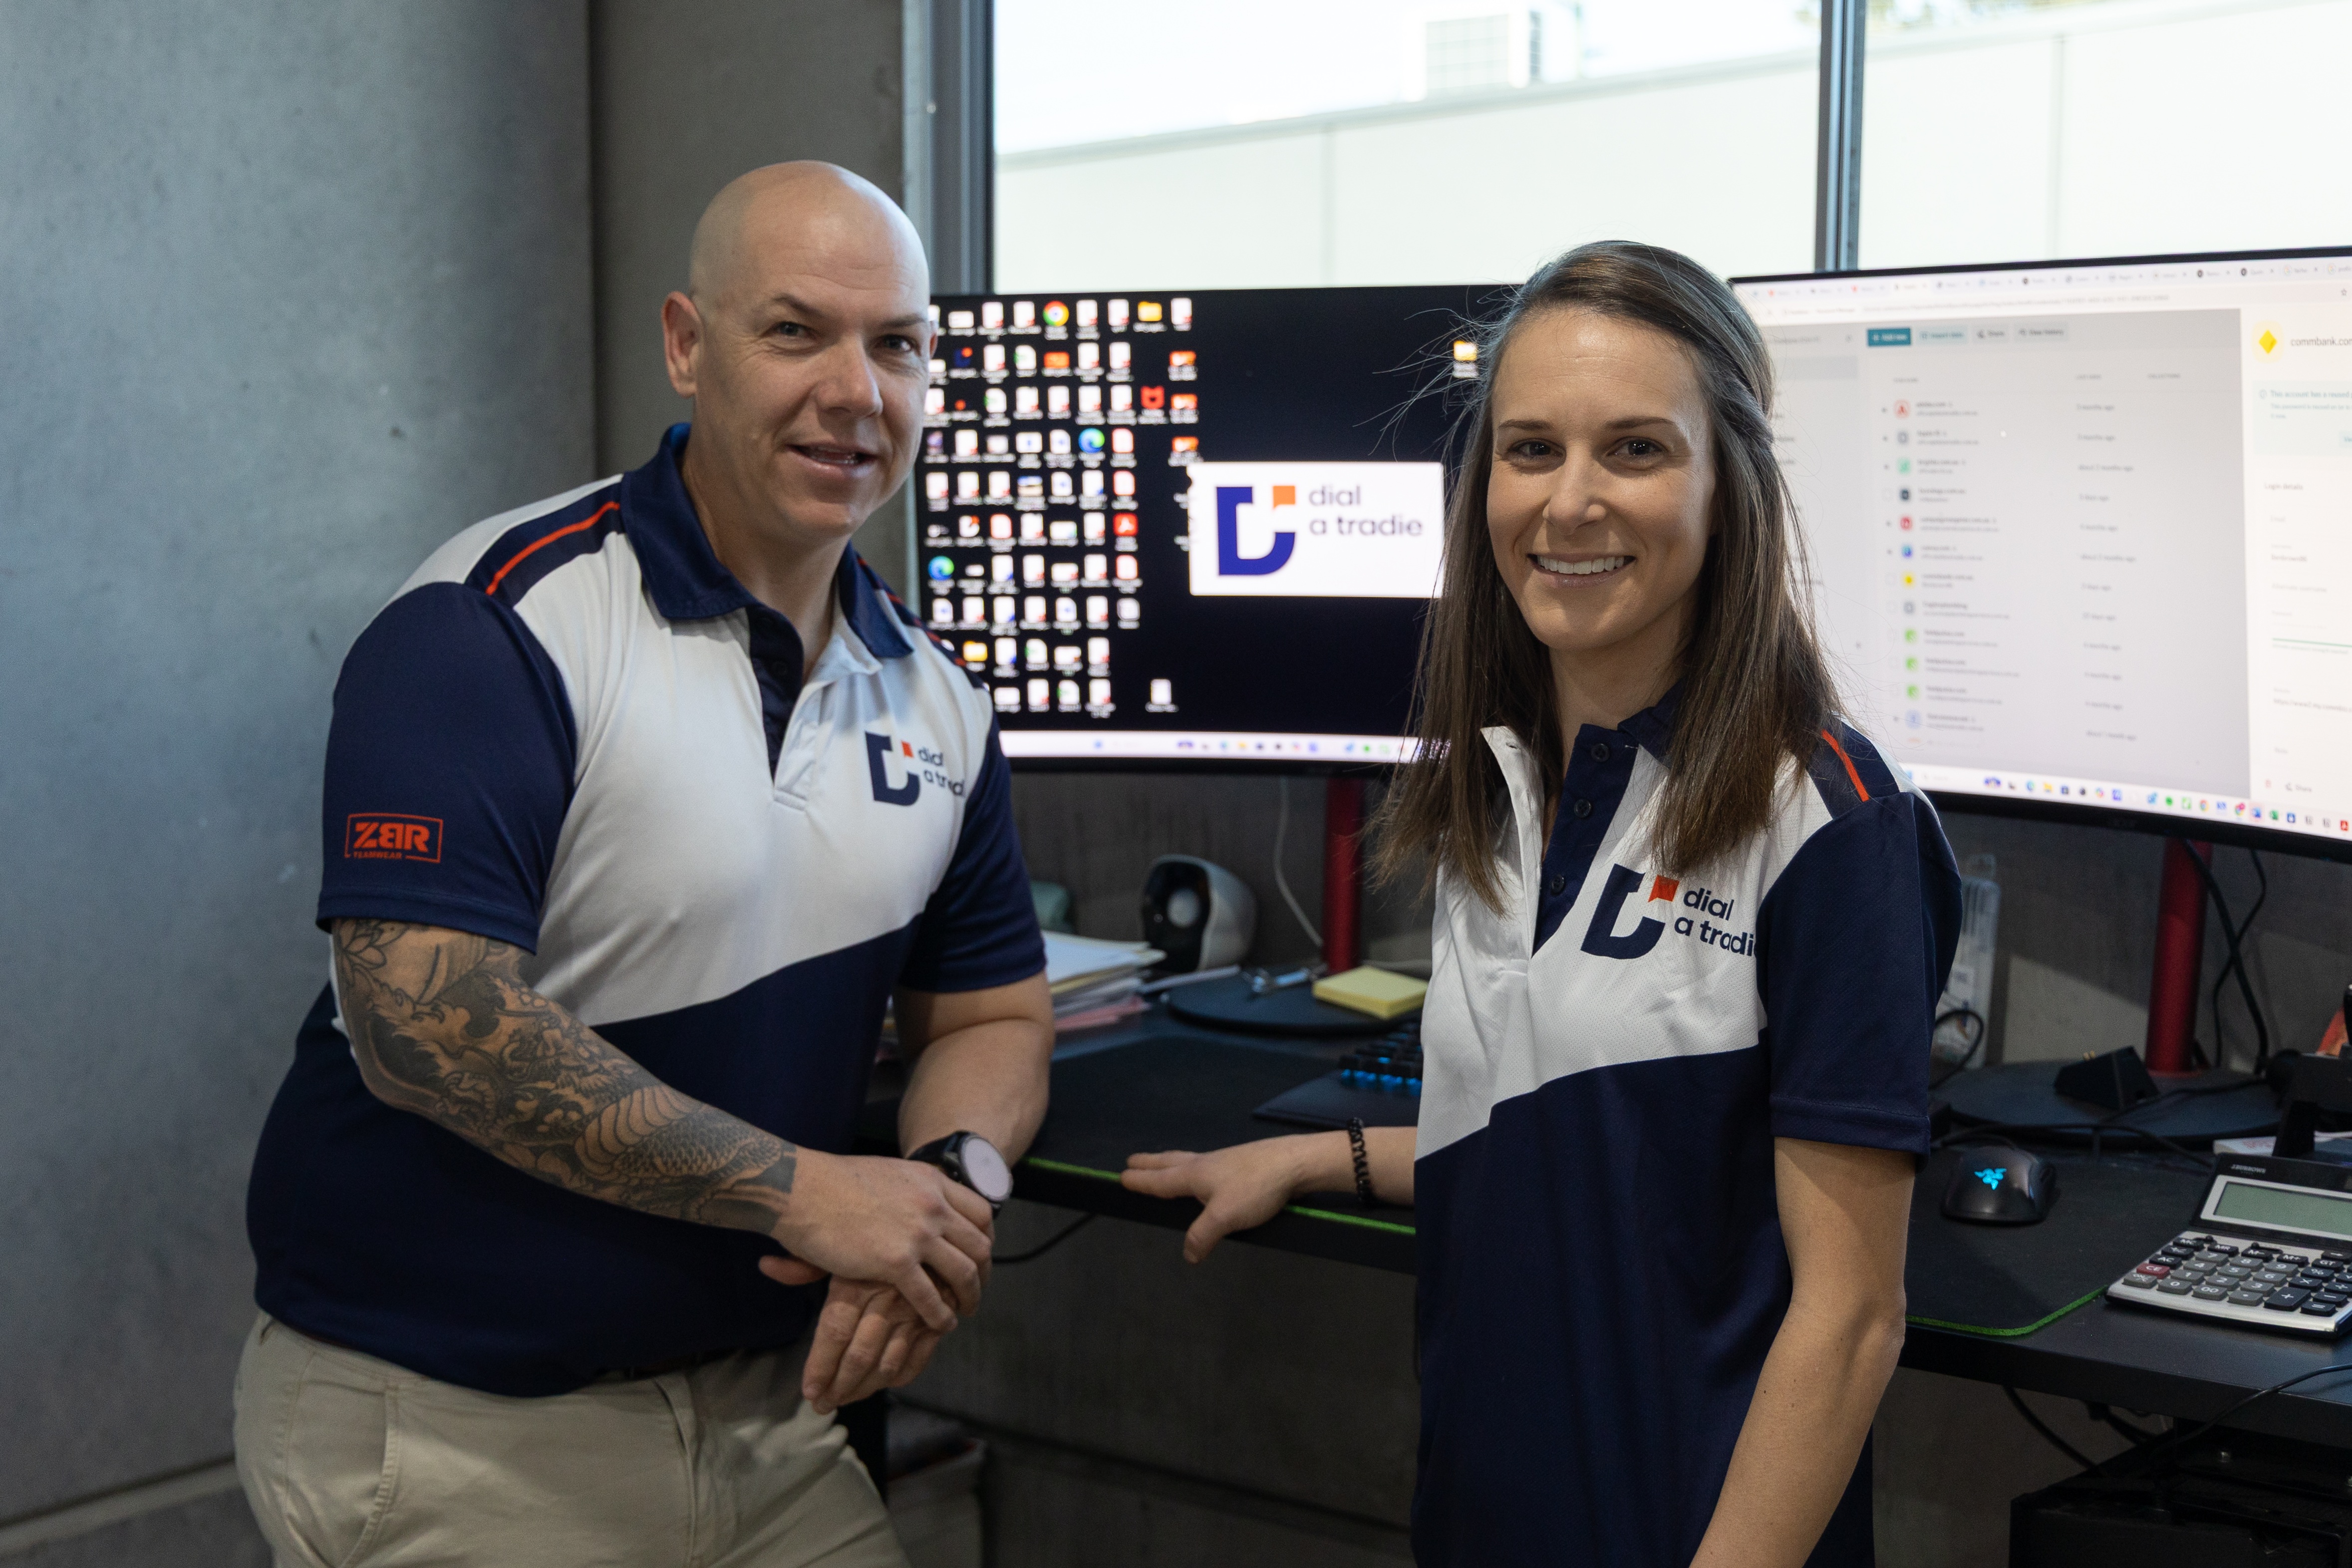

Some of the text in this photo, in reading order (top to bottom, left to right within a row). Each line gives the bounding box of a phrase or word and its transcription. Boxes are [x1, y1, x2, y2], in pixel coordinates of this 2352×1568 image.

[1309, 485, 1361, 506] dial
[1309, 514, 1423, 536] a tradie
[1683, 888, 1735, 921] dial
[1674, 917, 1694, 937] a
